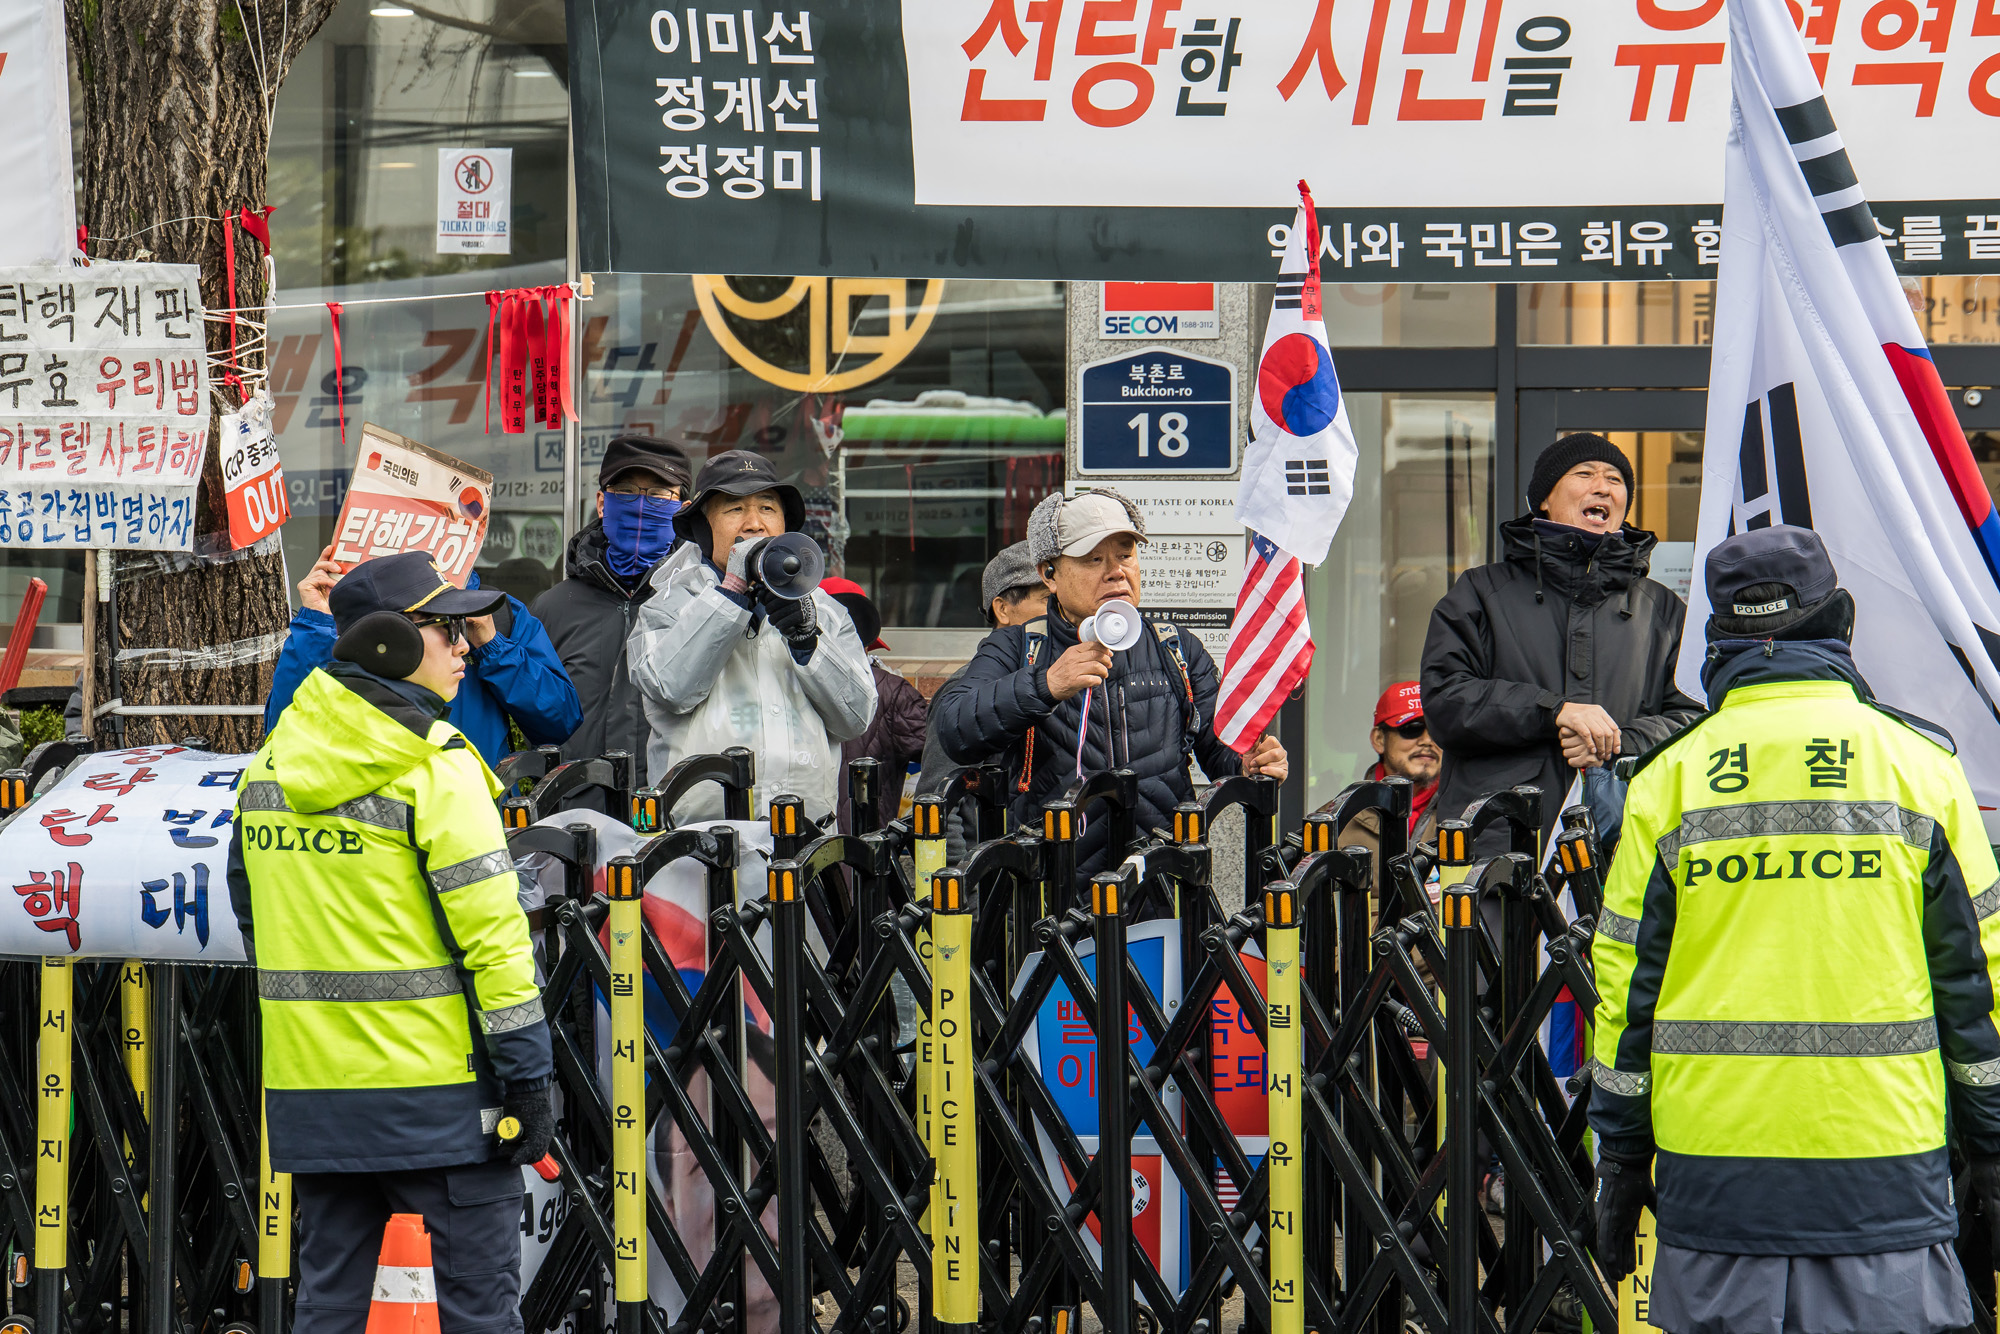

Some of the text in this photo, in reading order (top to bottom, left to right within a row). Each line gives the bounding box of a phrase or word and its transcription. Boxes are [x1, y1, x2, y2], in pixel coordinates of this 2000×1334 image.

[650, 8, 815, 64] 이미선
[1276, 0, 1572, 125] 시민을
[654, 76, 820, 133] 정계선
[658, 144, 822, 201] 정정미
[440, 220, 507, 232] 기대지 마세요
[457, 201, 490, 219] 절대
[1420, 222, 1562, 268] 국민은
[1580, 219, 1674, 267] 회유
[0, 283, 76, 342] 탄핵
[1105, 316, 1214, 335] SECOM 1588-3112
[0, 353, 199, 416] 무효 우리법
[513, 369, 522, 427] 탄핵무효
[549, 365, 560, 423] 탄핵무효
[1121, 385, 1193, 397] Bukchon-ro
[1128, 364, 1186, 384] 북촌로
[0, 421, 206, 478] 카르텔 사퇴해
[1127, 411, 1190, 458] 18
[225, 449, 245, 481] CCP
[382, 458, 420, 488] 국민의힘
[243, 467, 286, 533] OUT
[1152, 498, 1182, 506] TASTE
[1185, 498, 1197, 506] OF
[1200, 498, 1234, 506] KOREA
[1137, 541, 1203, 554] 한식문화공간
[1168, 569, 1193, 578] 한식을
[1195, 569, 1227, 578] 체험하고
[1172, 612, 1189, 620] Free
[1189, 612, 1227, 620] admission
[1736, 601, 1784, 614] POLICE
[1706, 738, 1855, 794] 경찰
[245, 824, 364, 855] POLICE
[1684, 849, 1882, 887] POLICE
[611, 971, 638, 1262] 질서유지선
[939, 988, 961, 1282] POLICE LINE
[1268, 1003, 1294, 1304] 질서유지선
